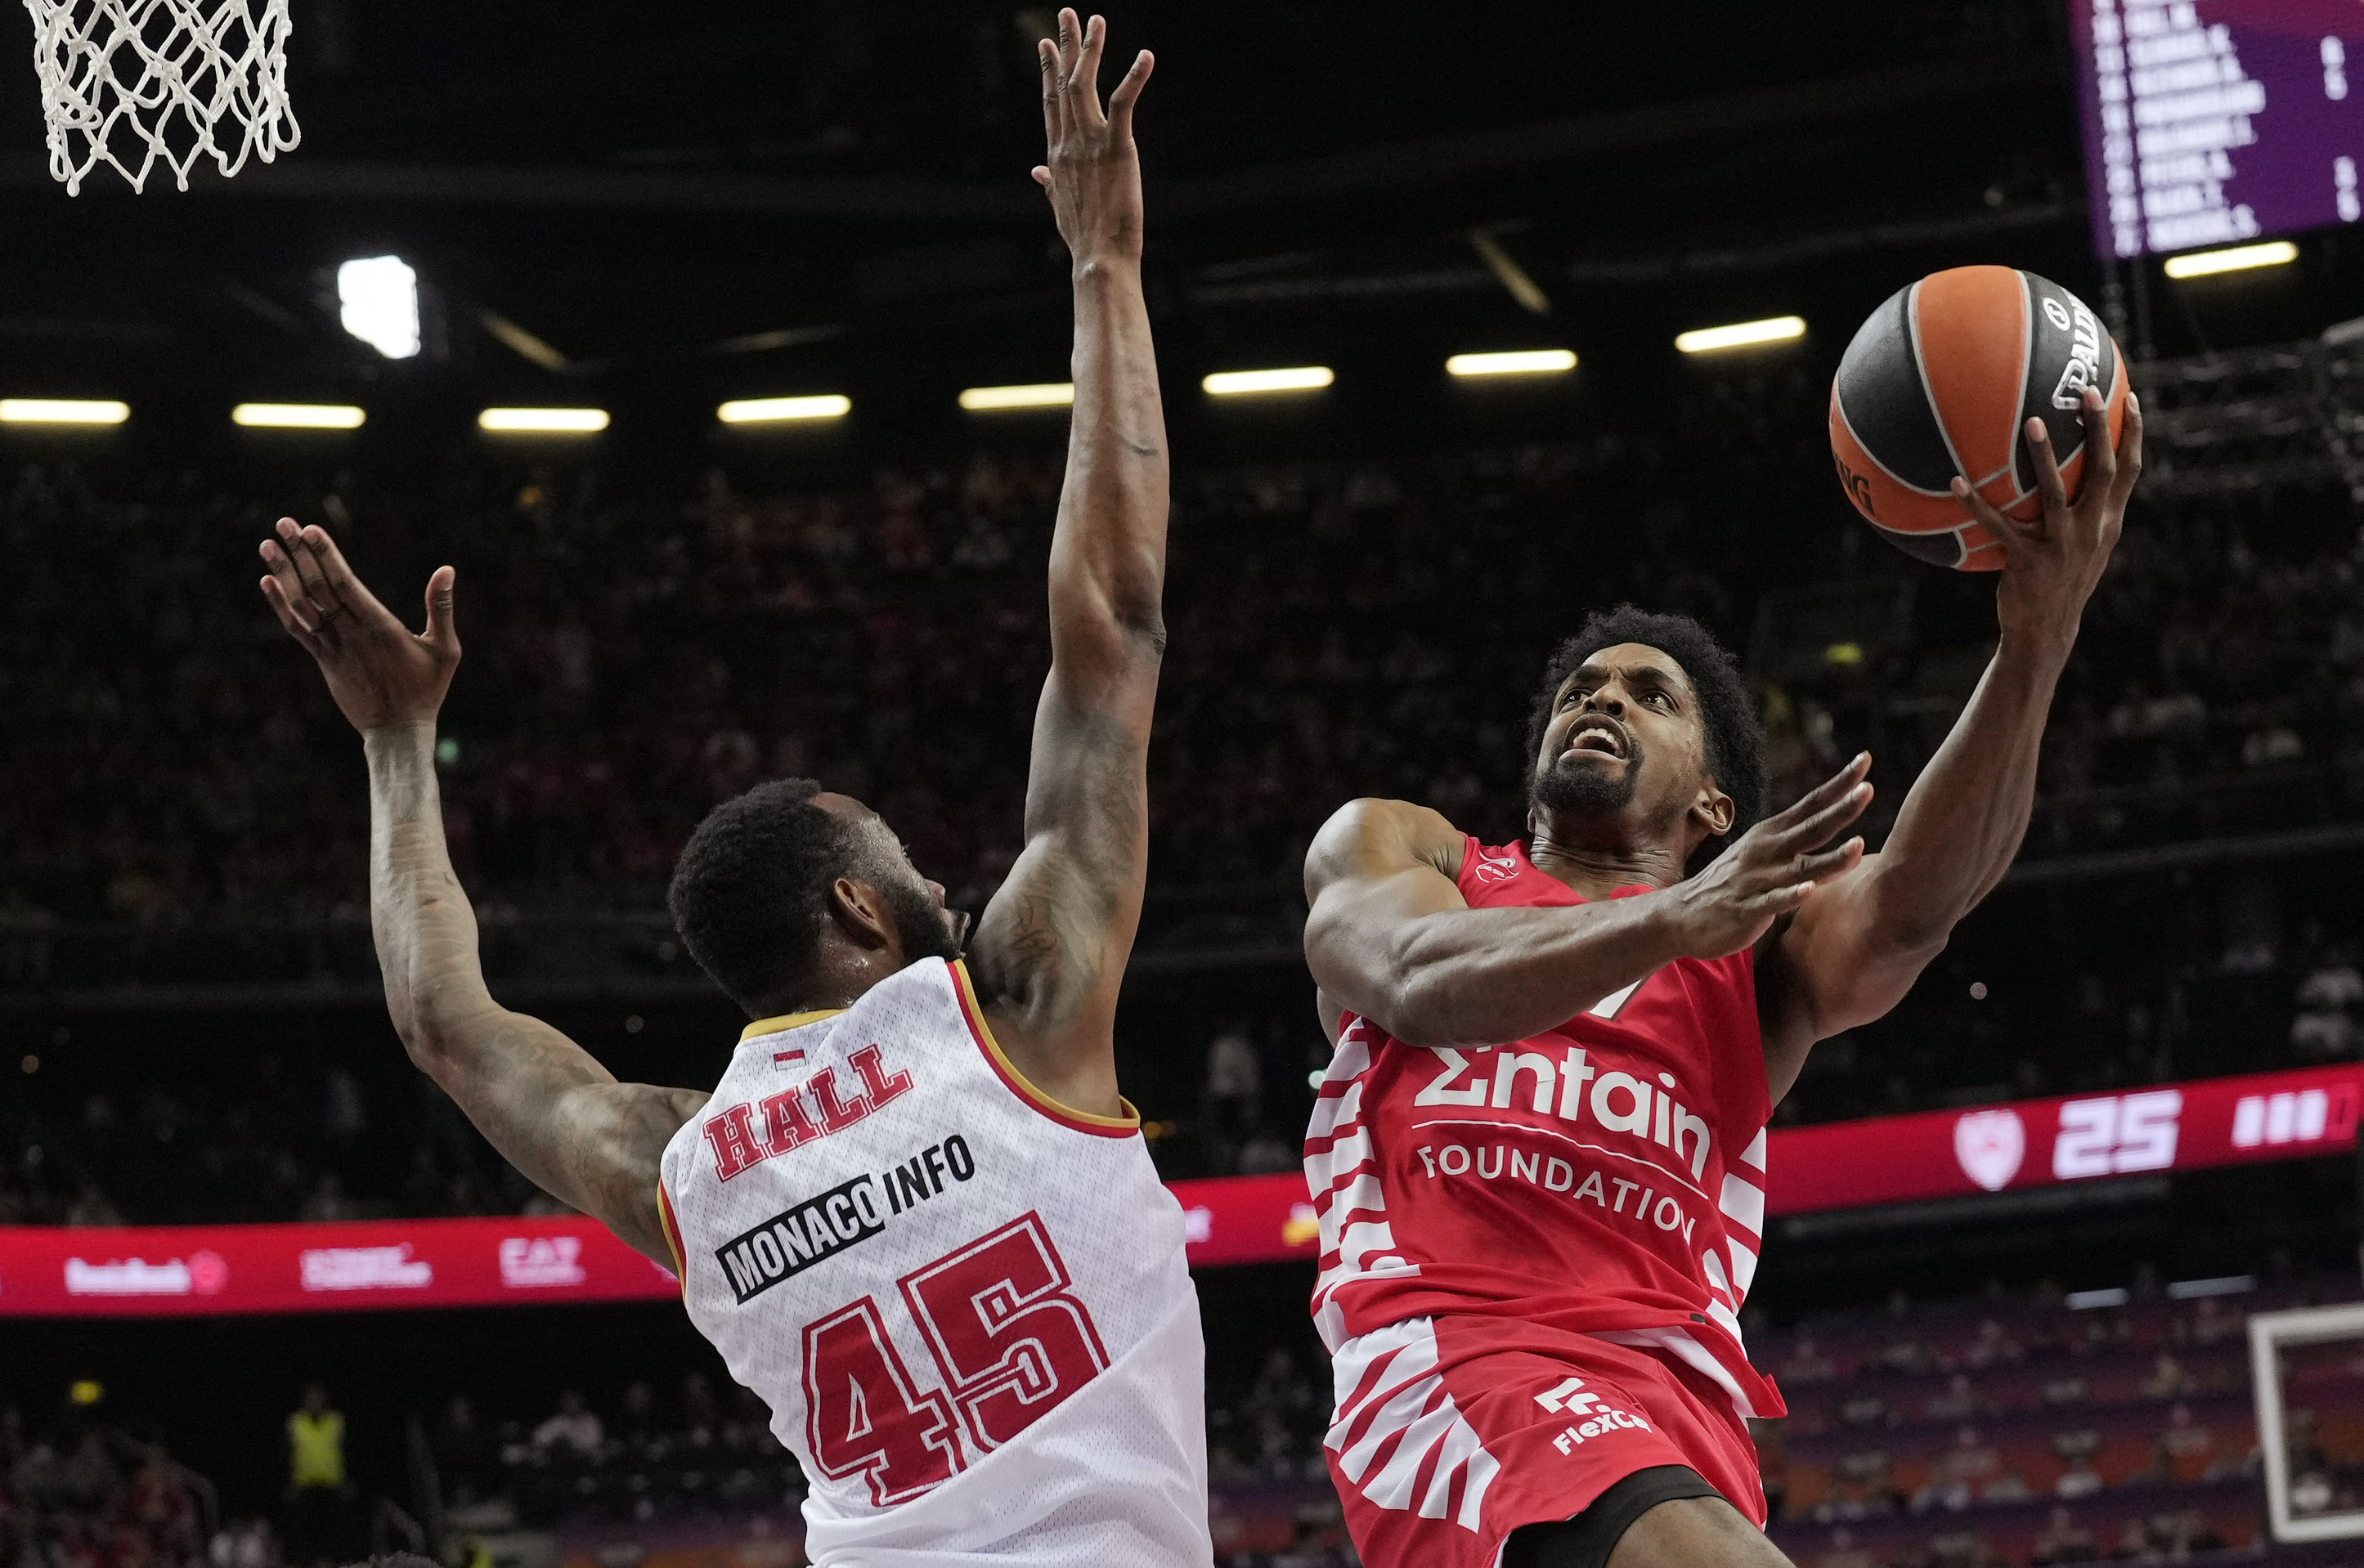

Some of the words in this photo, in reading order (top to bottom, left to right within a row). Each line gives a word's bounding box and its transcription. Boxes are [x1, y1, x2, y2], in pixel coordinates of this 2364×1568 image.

[702, 1044, 914, 1182] HALL
[2052, 1089, 2183, 1180] 25
[724, 1181, 885, 1297] MONACO
[882, 1135, 975, 1216] INFO
[801, 1210, 1111, 1508] 45
[1552, 1409, 1653, 1457] FlexCa
